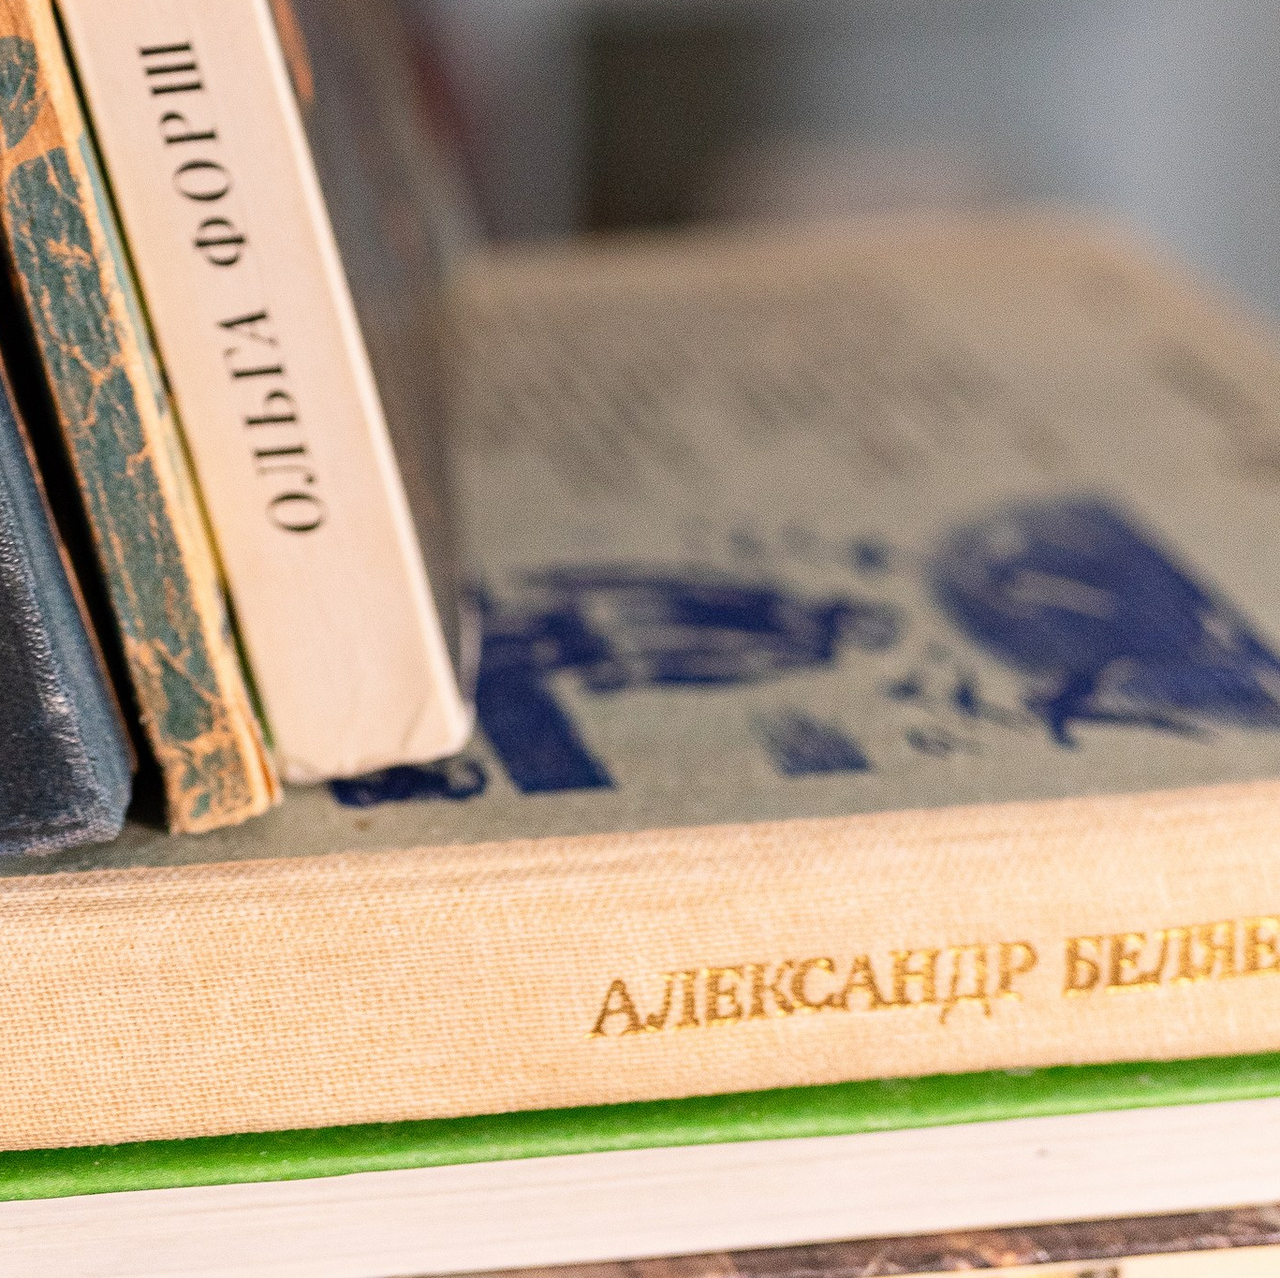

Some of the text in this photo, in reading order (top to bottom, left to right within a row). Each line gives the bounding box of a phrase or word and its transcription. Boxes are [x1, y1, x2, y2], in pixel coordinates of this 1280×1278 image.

[138, 40, 246, 268] ФОРШ
[218, 309, 327, 534] ОЛЬГА
[585, 938, 1038, 1040] АЛЕКСАНДР
